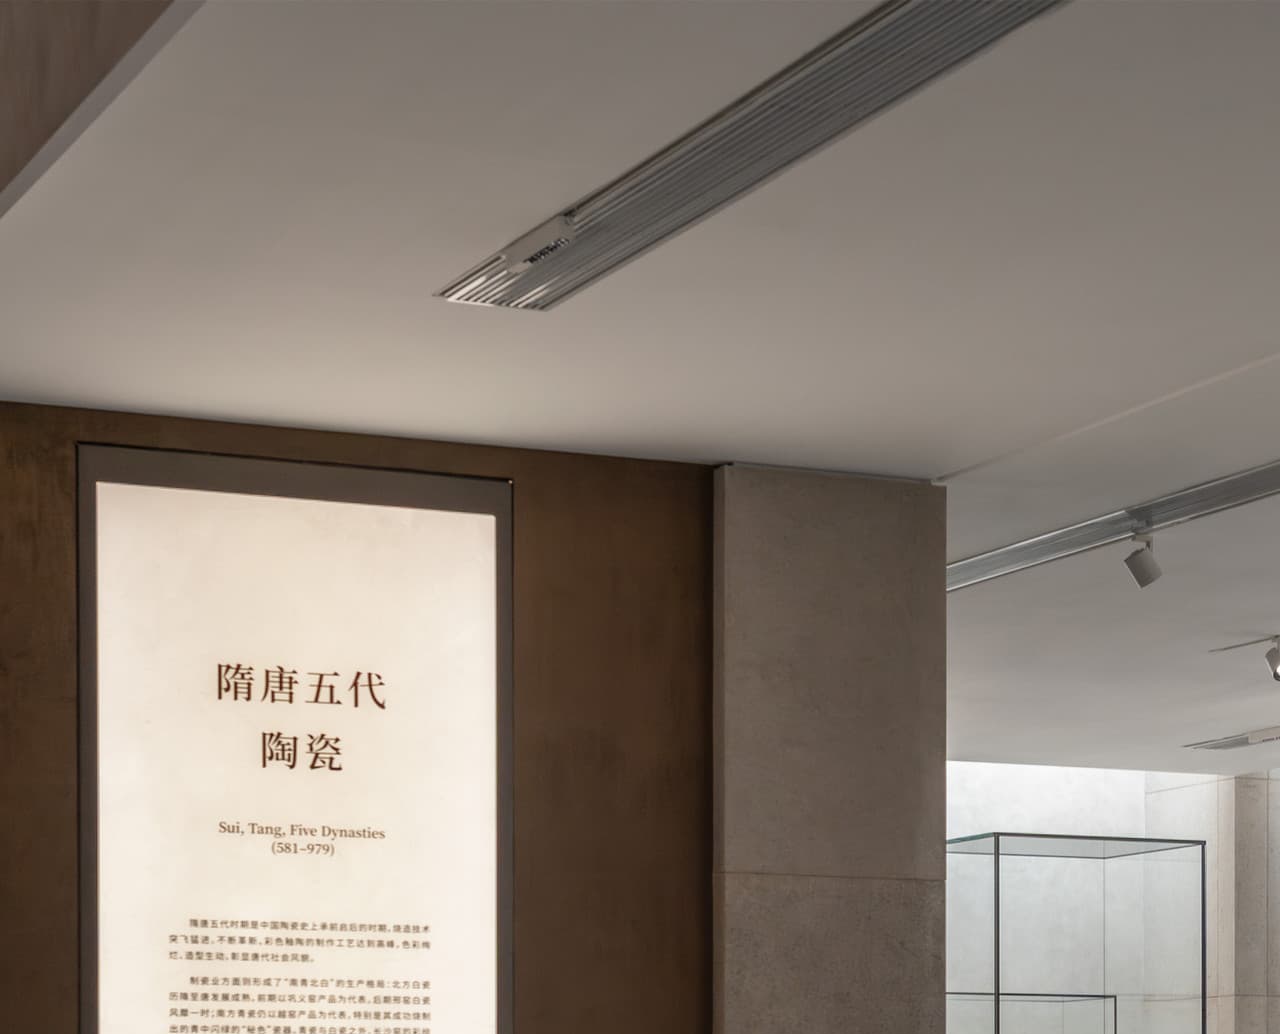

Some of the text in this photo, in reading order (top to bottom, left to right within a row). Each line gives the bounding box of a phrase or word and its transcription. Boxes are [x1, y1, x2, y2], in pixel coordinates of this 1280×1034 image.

[217, 663, 386, 710] 隋唐五代
[261, 731, 343, 771] 陶瓷
[219, 821, 386, 841] Sui, Tang, Five Dynasties
